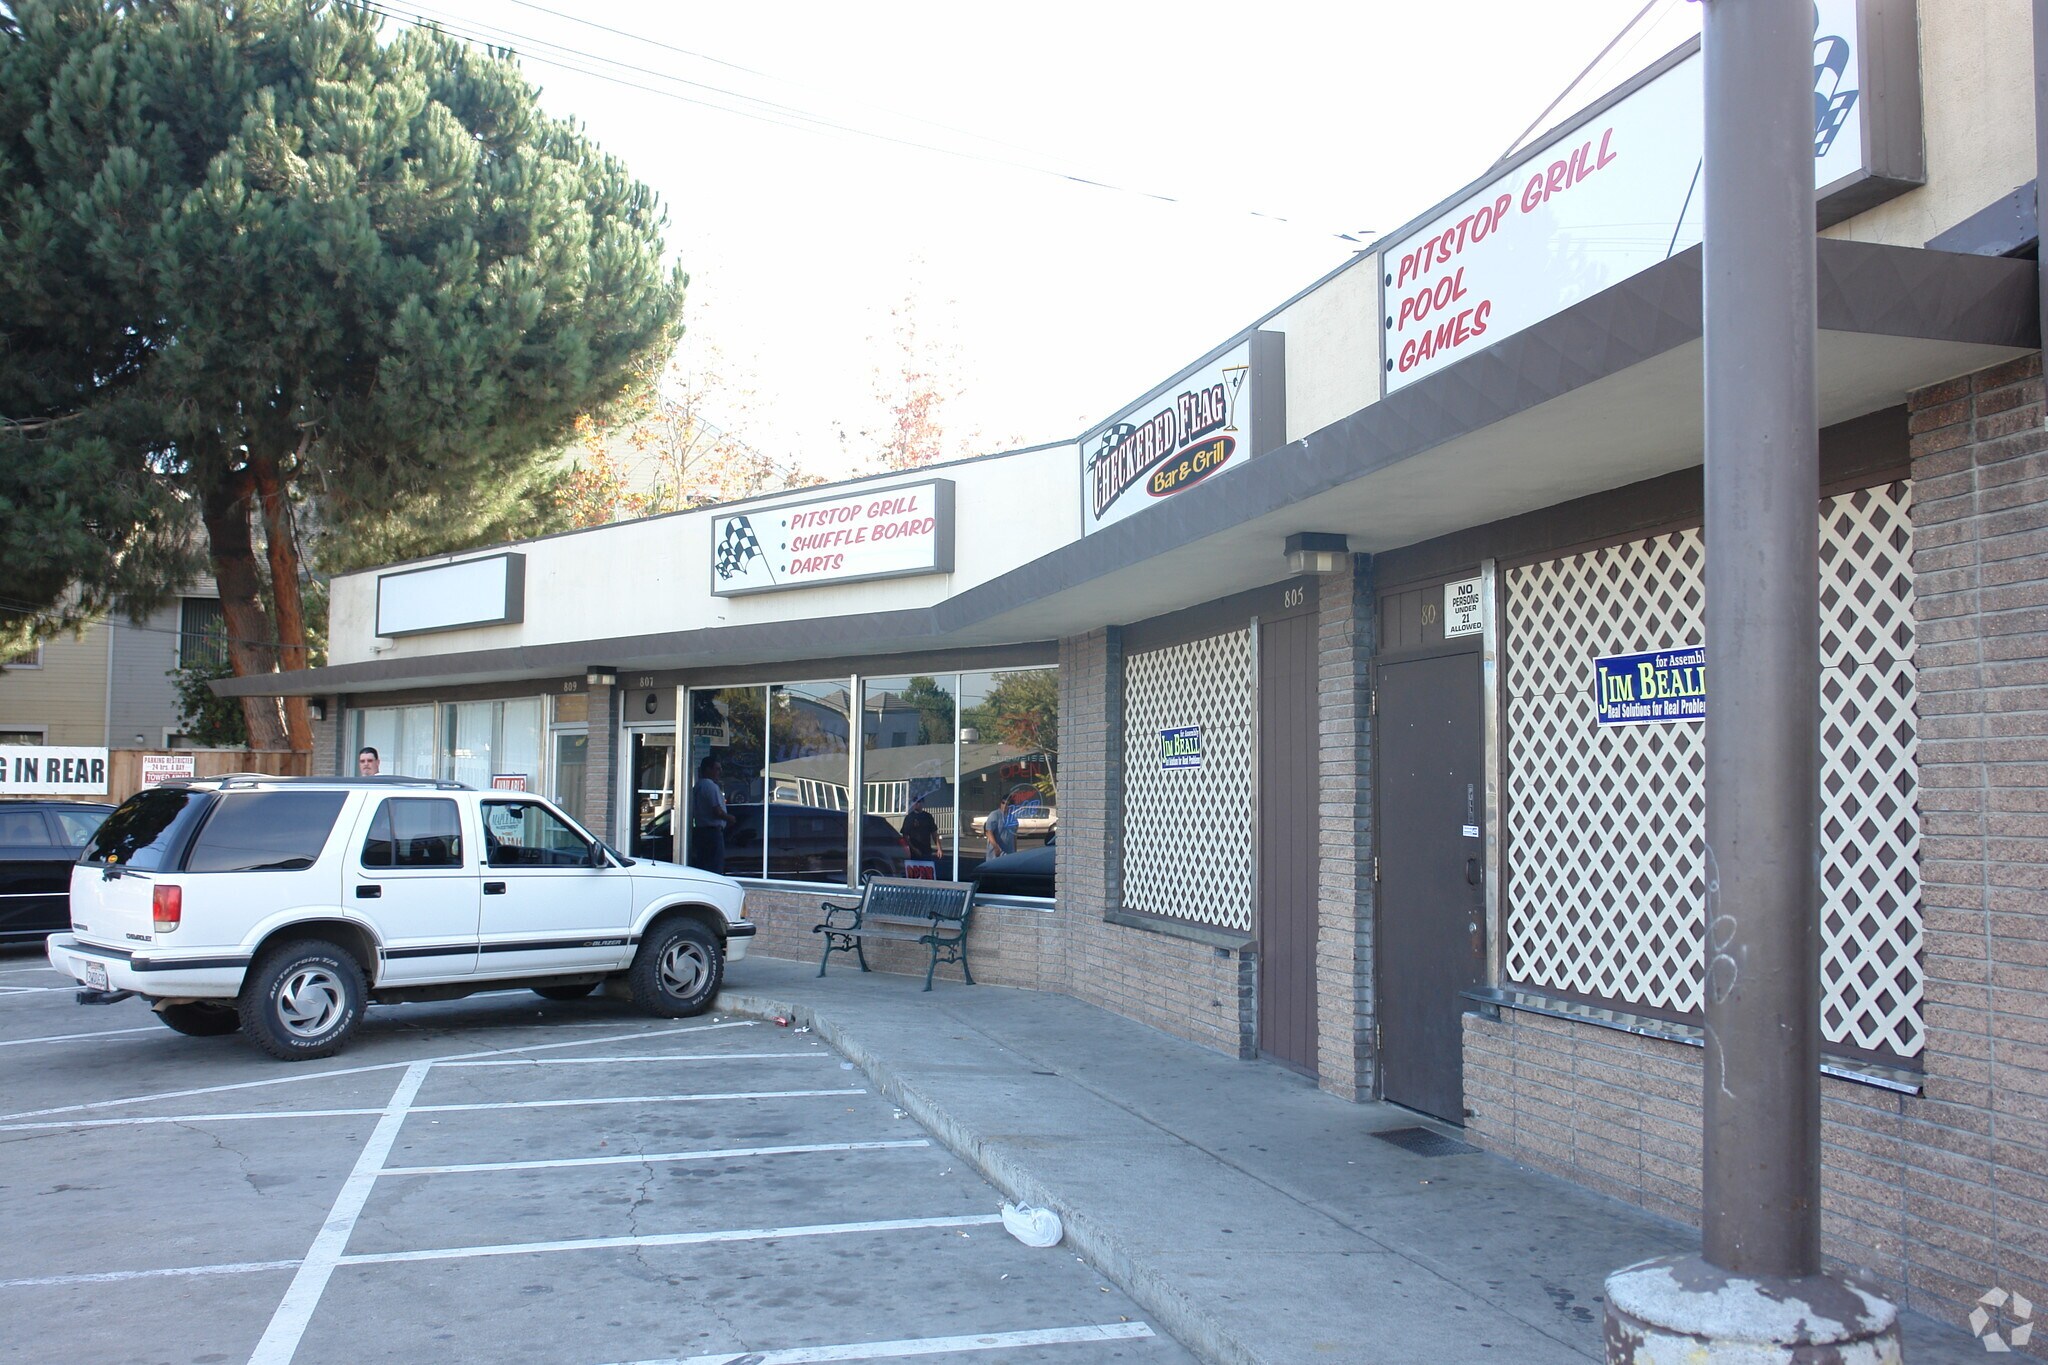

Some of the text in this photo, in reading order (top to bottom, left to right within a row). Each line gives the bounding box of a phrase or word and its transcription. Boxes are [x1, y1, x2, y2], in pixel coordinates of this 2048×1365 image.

[1397, 127, 1618, 290] PITSTOP GRILL
[1397, 266, 1468, 332] POOL
[1398, 299, 1492, 373] GAMES
[1093, 384, 1226, 519] CHECKERED FLAG
[1154, 439, 1225, 493] Bar & Grill
[790, 495, 918, 530] PITSTOP GRILL
[790, 517, 935, 552] SHUFFLE BOARD
[789, 553, 844, 575] DARTS
[1284, 586, 1304, 608] 805
[1452, 593, 1479, 608] PERSONS
[1458, 584, 1473, 596] NO
[1454, 604, 1477, 614] UNDER
[1461, 613, 1470, 624] 21
[1450, 621, 1482, 633] ALLOWED
[1655, 650, 1705, 668] for Assembl
[563, 681, 578, 692] 809
[640, 677, 654, 687] 807
[1598, 667, 1635, 714] JIM
[1607, 698, 1706, 719] Real Solutions for Real Proble
[1161, 733, 1200, 763] JIM BEALL
[15, 757, 39, 783] IN
[46, 758, 105, 784] REAR
[166, 757, 193, 765] RESTRICTED
[1000, 760, 1041, 779] OPEN
[269, 956, 339, 1000] All-Terrain T/A
[291, 1009, 354, 1048] BFGoodrich
